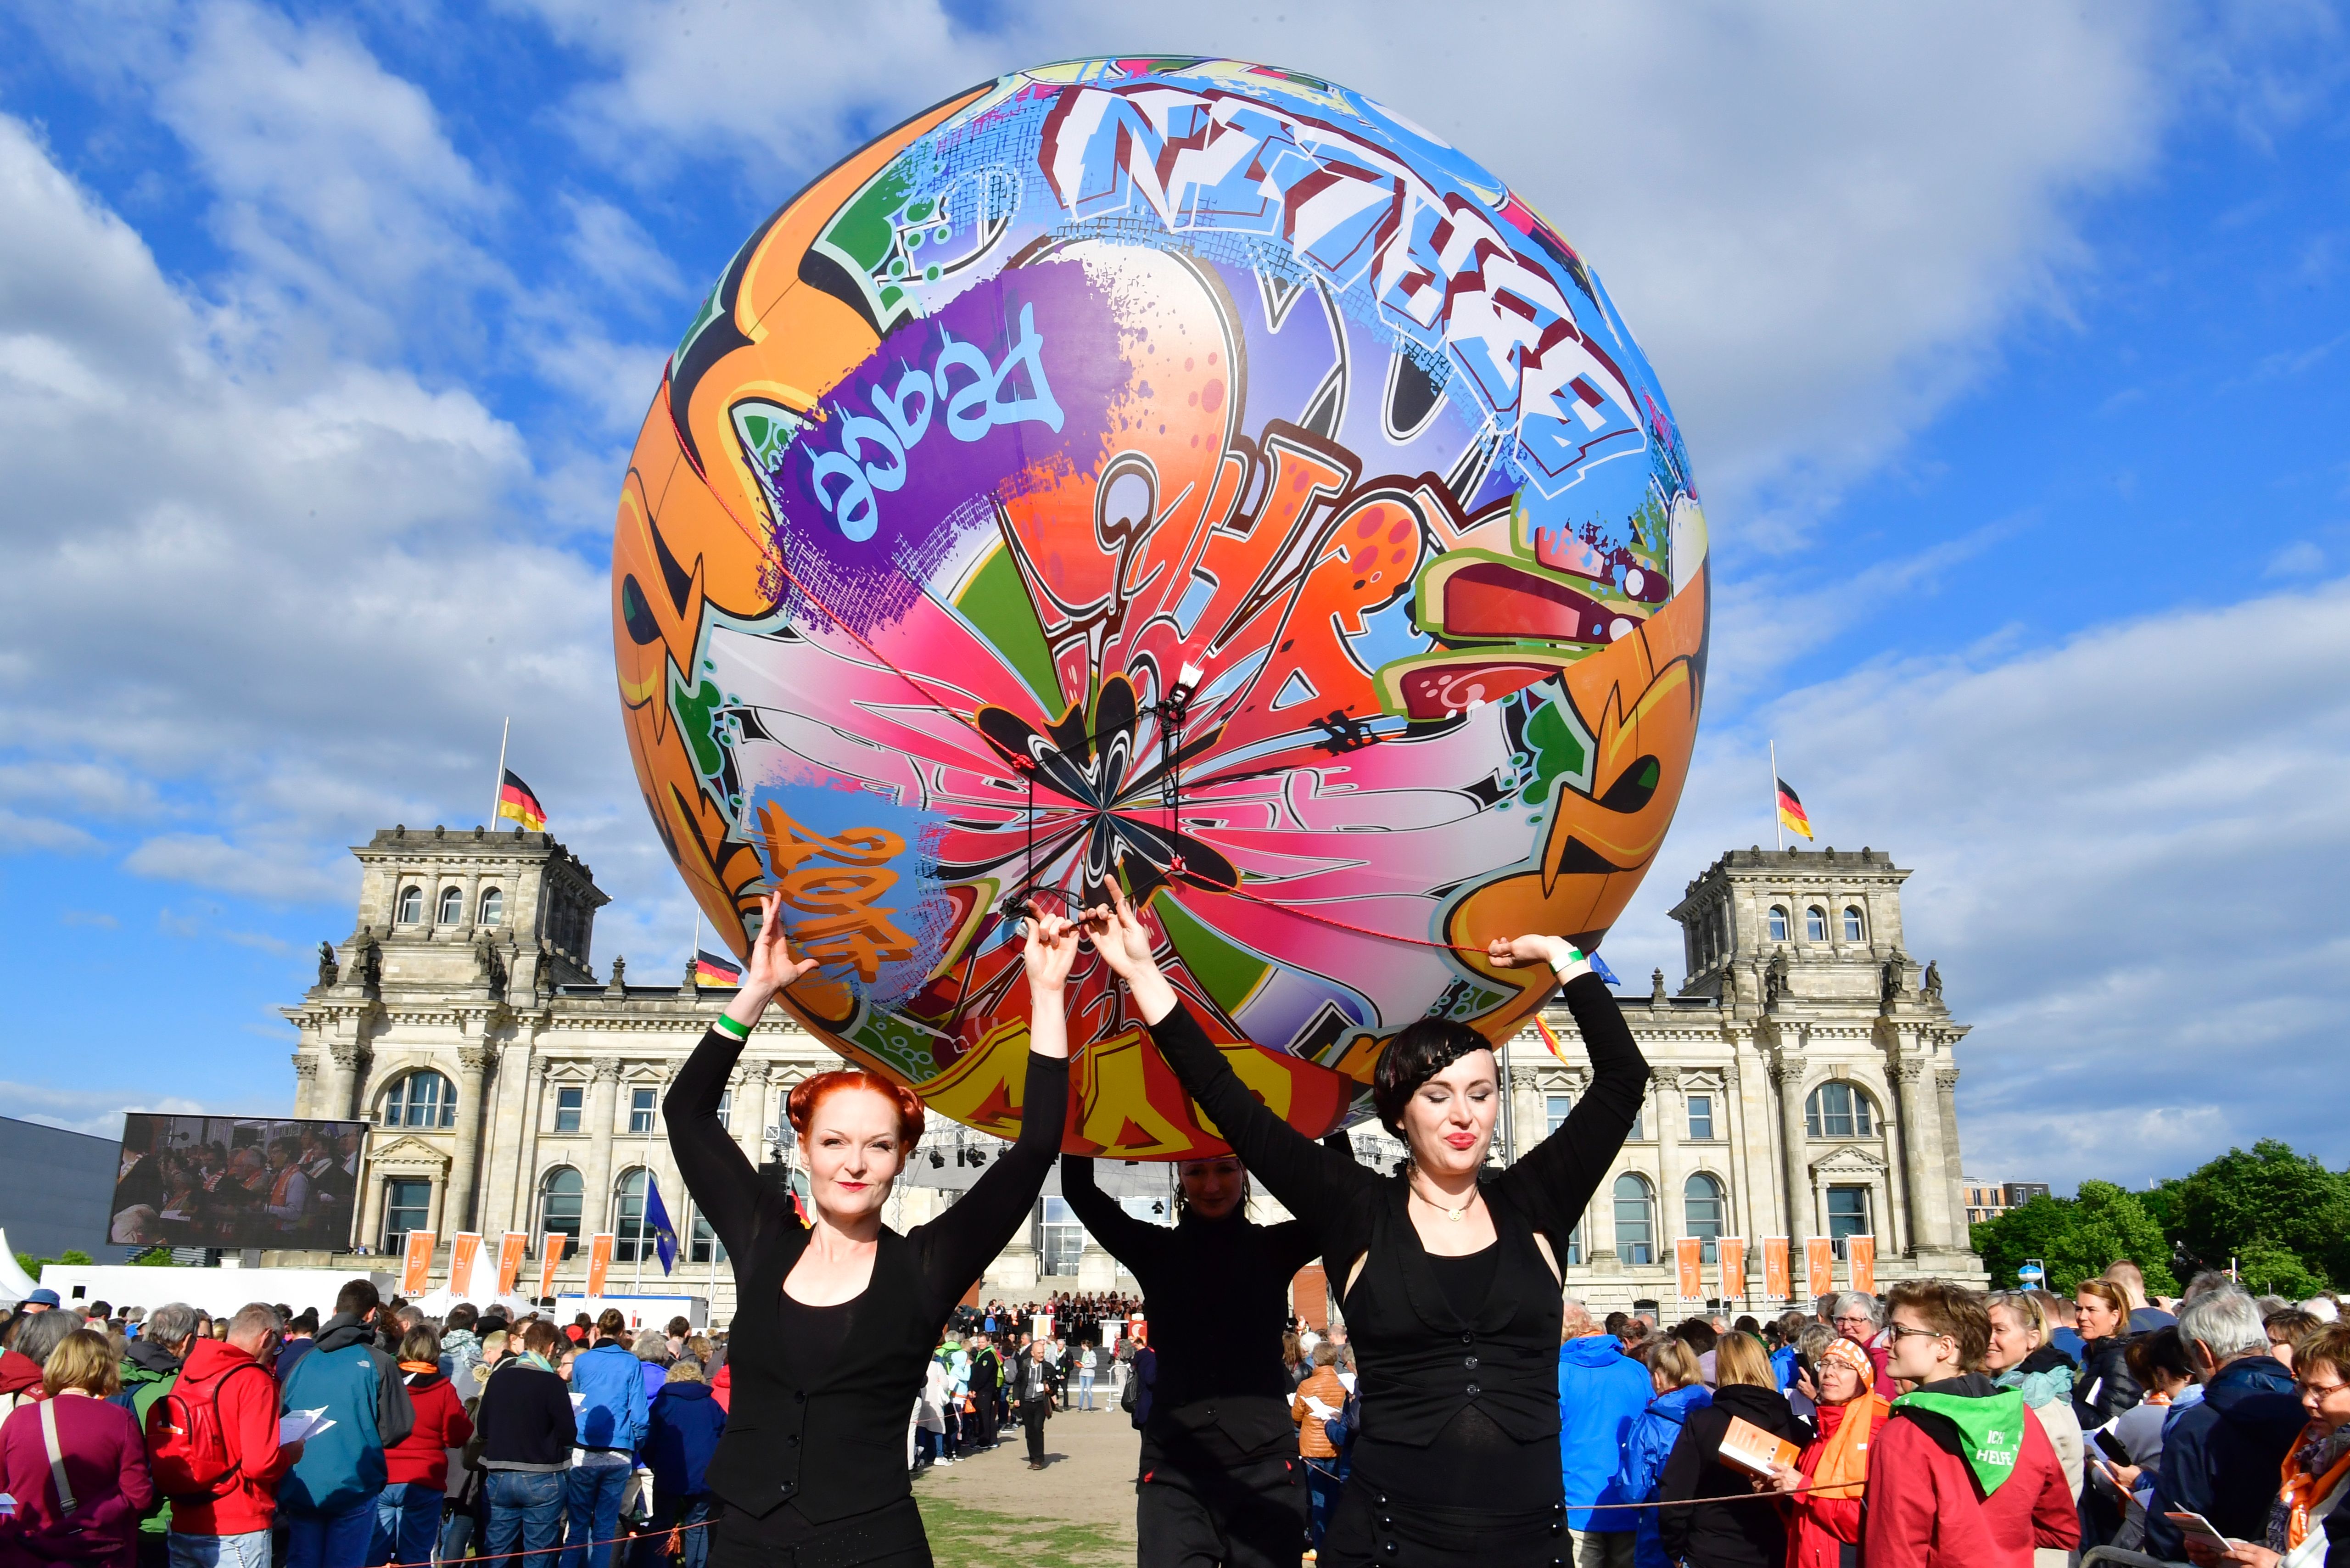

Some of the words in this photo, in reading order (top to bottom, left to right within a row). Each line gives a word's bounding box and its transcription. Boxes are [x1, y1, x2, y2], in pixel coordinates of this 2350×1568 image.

[1038, 82, 1648, 499] BERLIN
[802, 302, 1064, 542] Peace
[1975, 1449, 2013, 1466] HELFE
[1986, 1430, 2005, 1445] ICH
